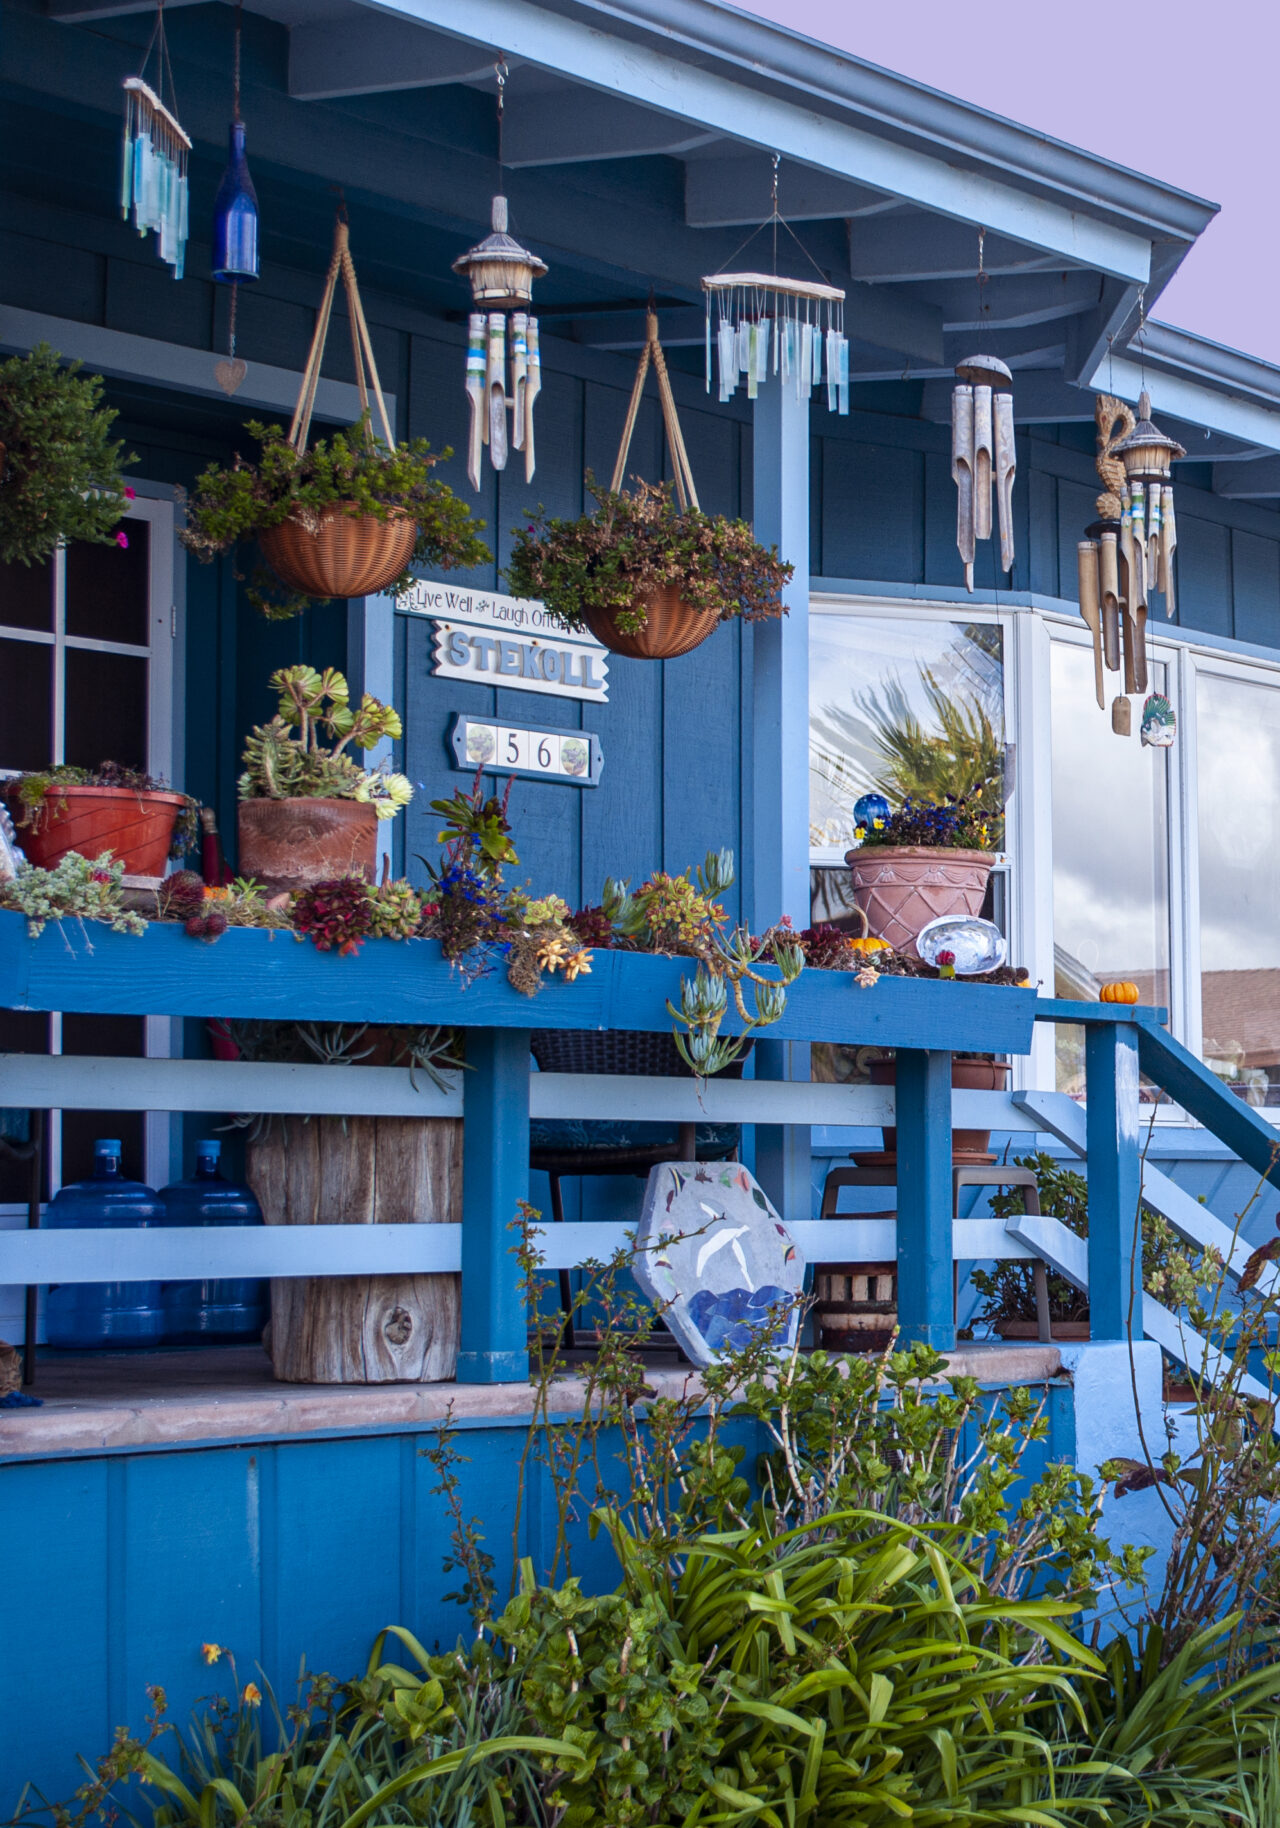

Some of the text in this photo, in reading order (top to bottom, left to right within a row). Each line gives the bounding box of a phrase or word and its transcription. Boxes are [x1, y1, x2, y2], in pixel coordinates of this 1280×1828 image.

[417, 588, 443, 608] Live
[445, 592, 473, 613] Well
[492, 601, 529, 627] Laugh
[449, 631, 603, 689] STEKOLL
